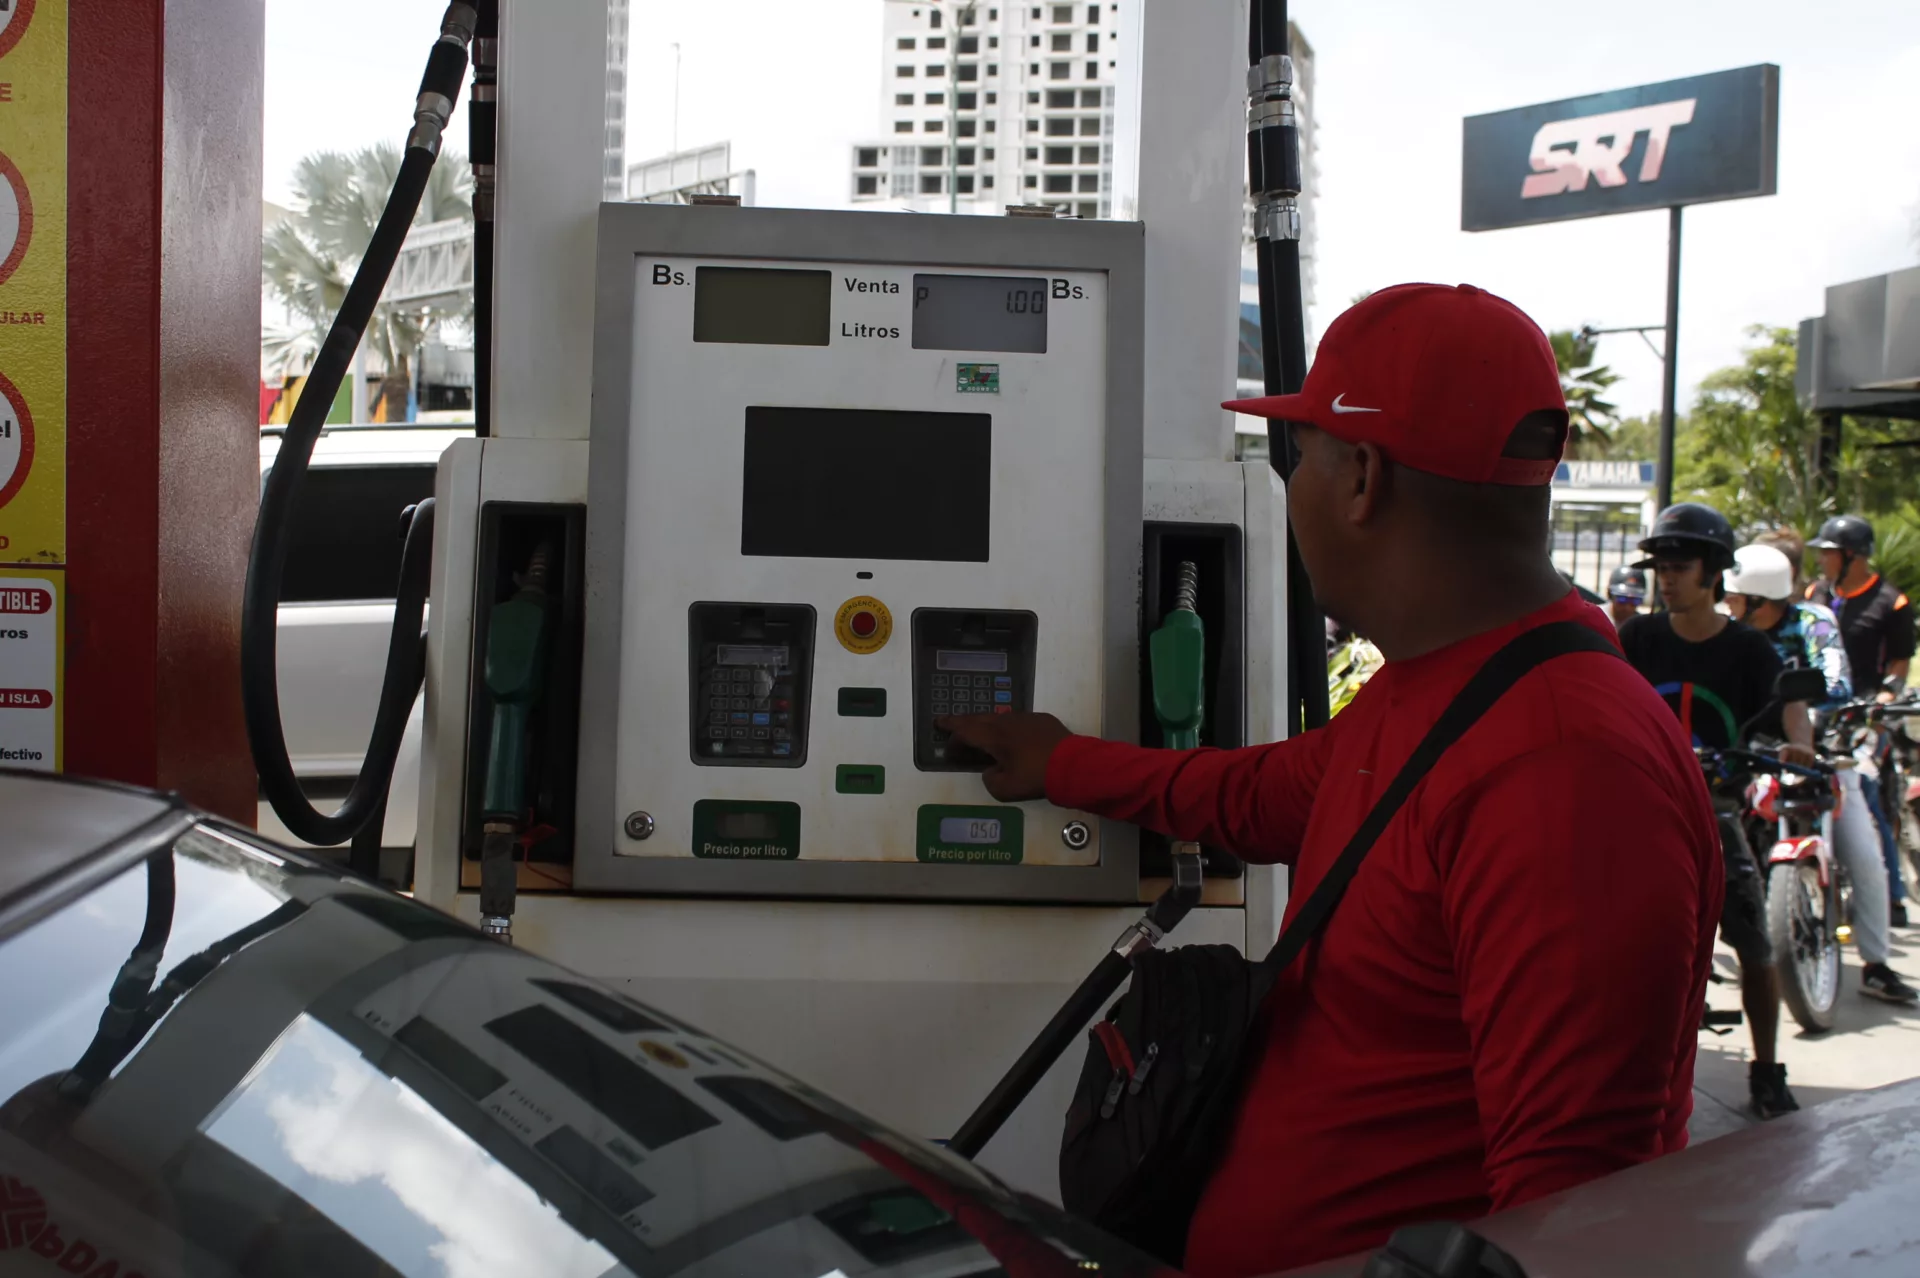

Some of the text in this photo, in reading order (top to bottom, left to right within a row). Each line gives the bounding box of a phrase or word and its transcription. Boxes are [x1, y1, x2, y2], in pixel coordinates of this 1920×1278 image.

[1520, 98, 1697, 199] SRT
[652, 264, 691, 287] Bs.
[844, 277, 900, 294] Venta
[915, 287, 929, 309] P
[1052, 278, 1090, 300] Bs.
[841, 322, 900, 339] Litros
[1568, 461, 1641, 485] YAMAHA
[839, 600, 889, 625] EMERGENCY STOP
[9, 693, 40, 704] ISLA
[703, 842, 788, 857] Precio por litro
[928, 847, 1012, 861] Precio por litro
